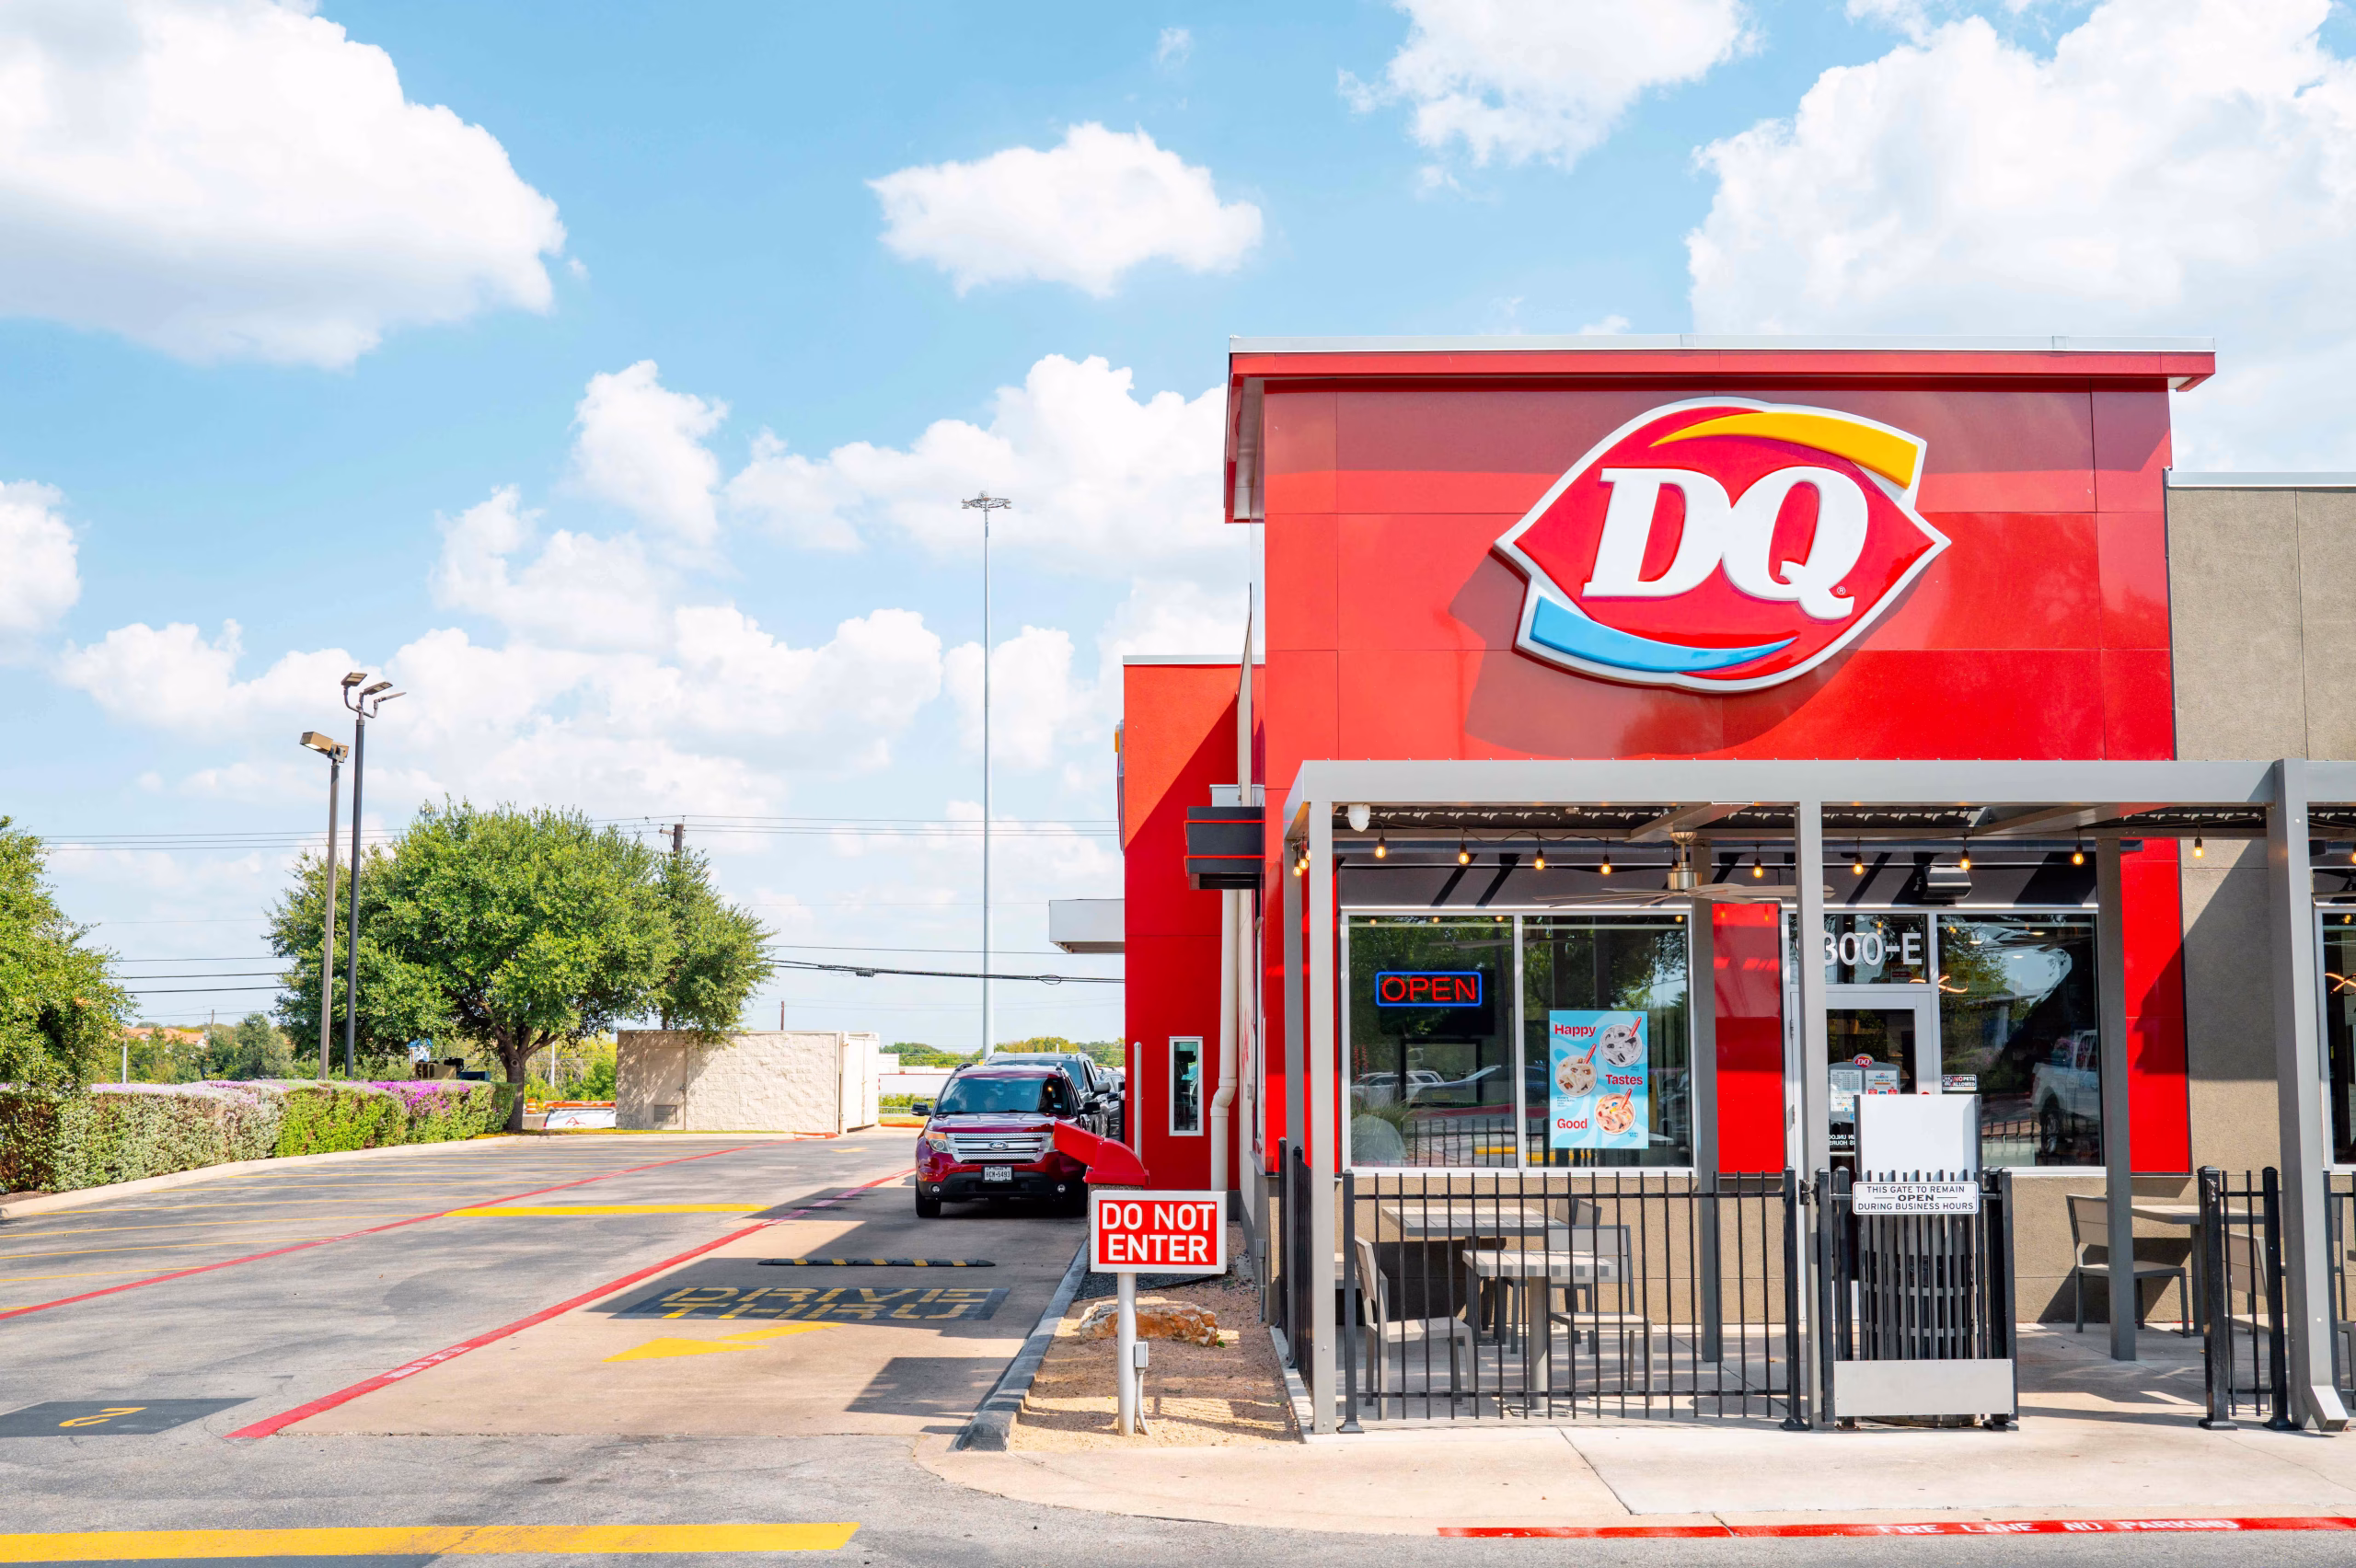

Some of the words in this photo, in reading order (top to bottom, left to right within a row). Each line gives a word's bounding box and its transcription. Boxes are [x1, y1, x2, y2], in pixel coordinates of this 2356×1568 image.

[1581, 465, 1869, 621] DQ
[1796, 931, 1923, 967] 300-E
[1380, 976, 1477, 1002] OPEN
[1554, 1024, 1597, 1037] Happy
[1857, 1058, 1870, 1066] DQ
[1605, 1074, 1644, 1085] Tastes
[1556, 1118, 1588, 1129] Good
[1102, 1202, 1143, 1231] DO
[1154, 1203, 1216, 1231] NOT
[1107, 1234, 1209, 1262] ENTER
[661, 1286, 995, 1303] DRIVE
[660, 1303, 971, 1320] THRU
[1877, 1524, 1945, 1534] FIRE
[1960, 1522, 2039, 1533] LANE
[2062, 1521, 2104, 1531] NO
[2118, 1519, 2240, 1530] PARKING
